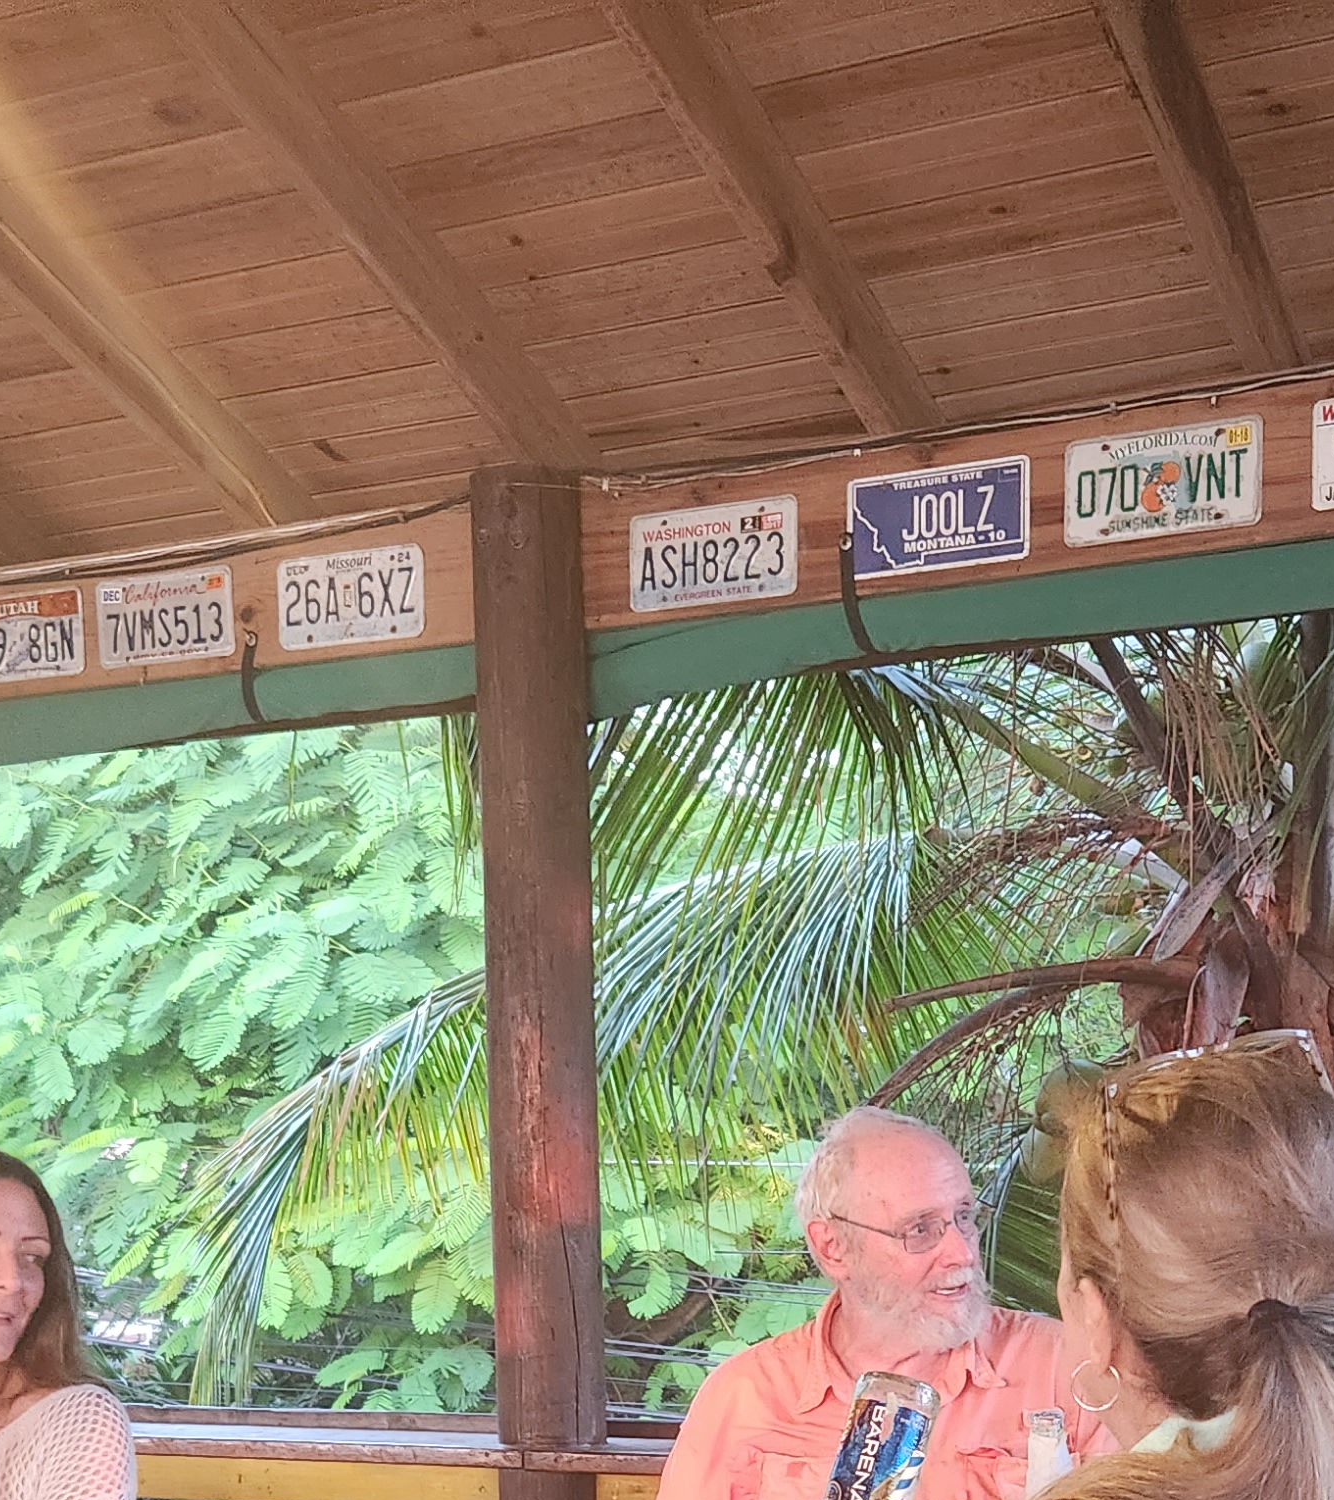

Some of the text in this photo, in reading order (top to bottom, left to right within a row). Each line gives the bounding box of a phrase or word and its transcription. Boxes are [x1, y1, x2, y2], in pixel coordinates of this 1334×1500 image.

[1109, 432, 1217, 463] MYFLORIDA.COM
[892, 475, 948, 491] TREASURE
[951, 470, 984, 483] STATE
[1185, 448, 1248, 503] VNT
[1175, 507, 1215, 526] STATE
[642, 520, 731, 544] WASHINGTON
[904, 534, 976, 553] MONTANA
[640, 531, 784, 592] ASH8223
[103, 590, 120, 602] DEC
[125, 581, 206, 606] California
[285, 566, 415, 627] 26A 6XZ
[674, 585, 753, 603] EVERGREEN STATE
[28, 618, 74, 663] 8GN
[106, 602, 223, 654] 7VMS513
